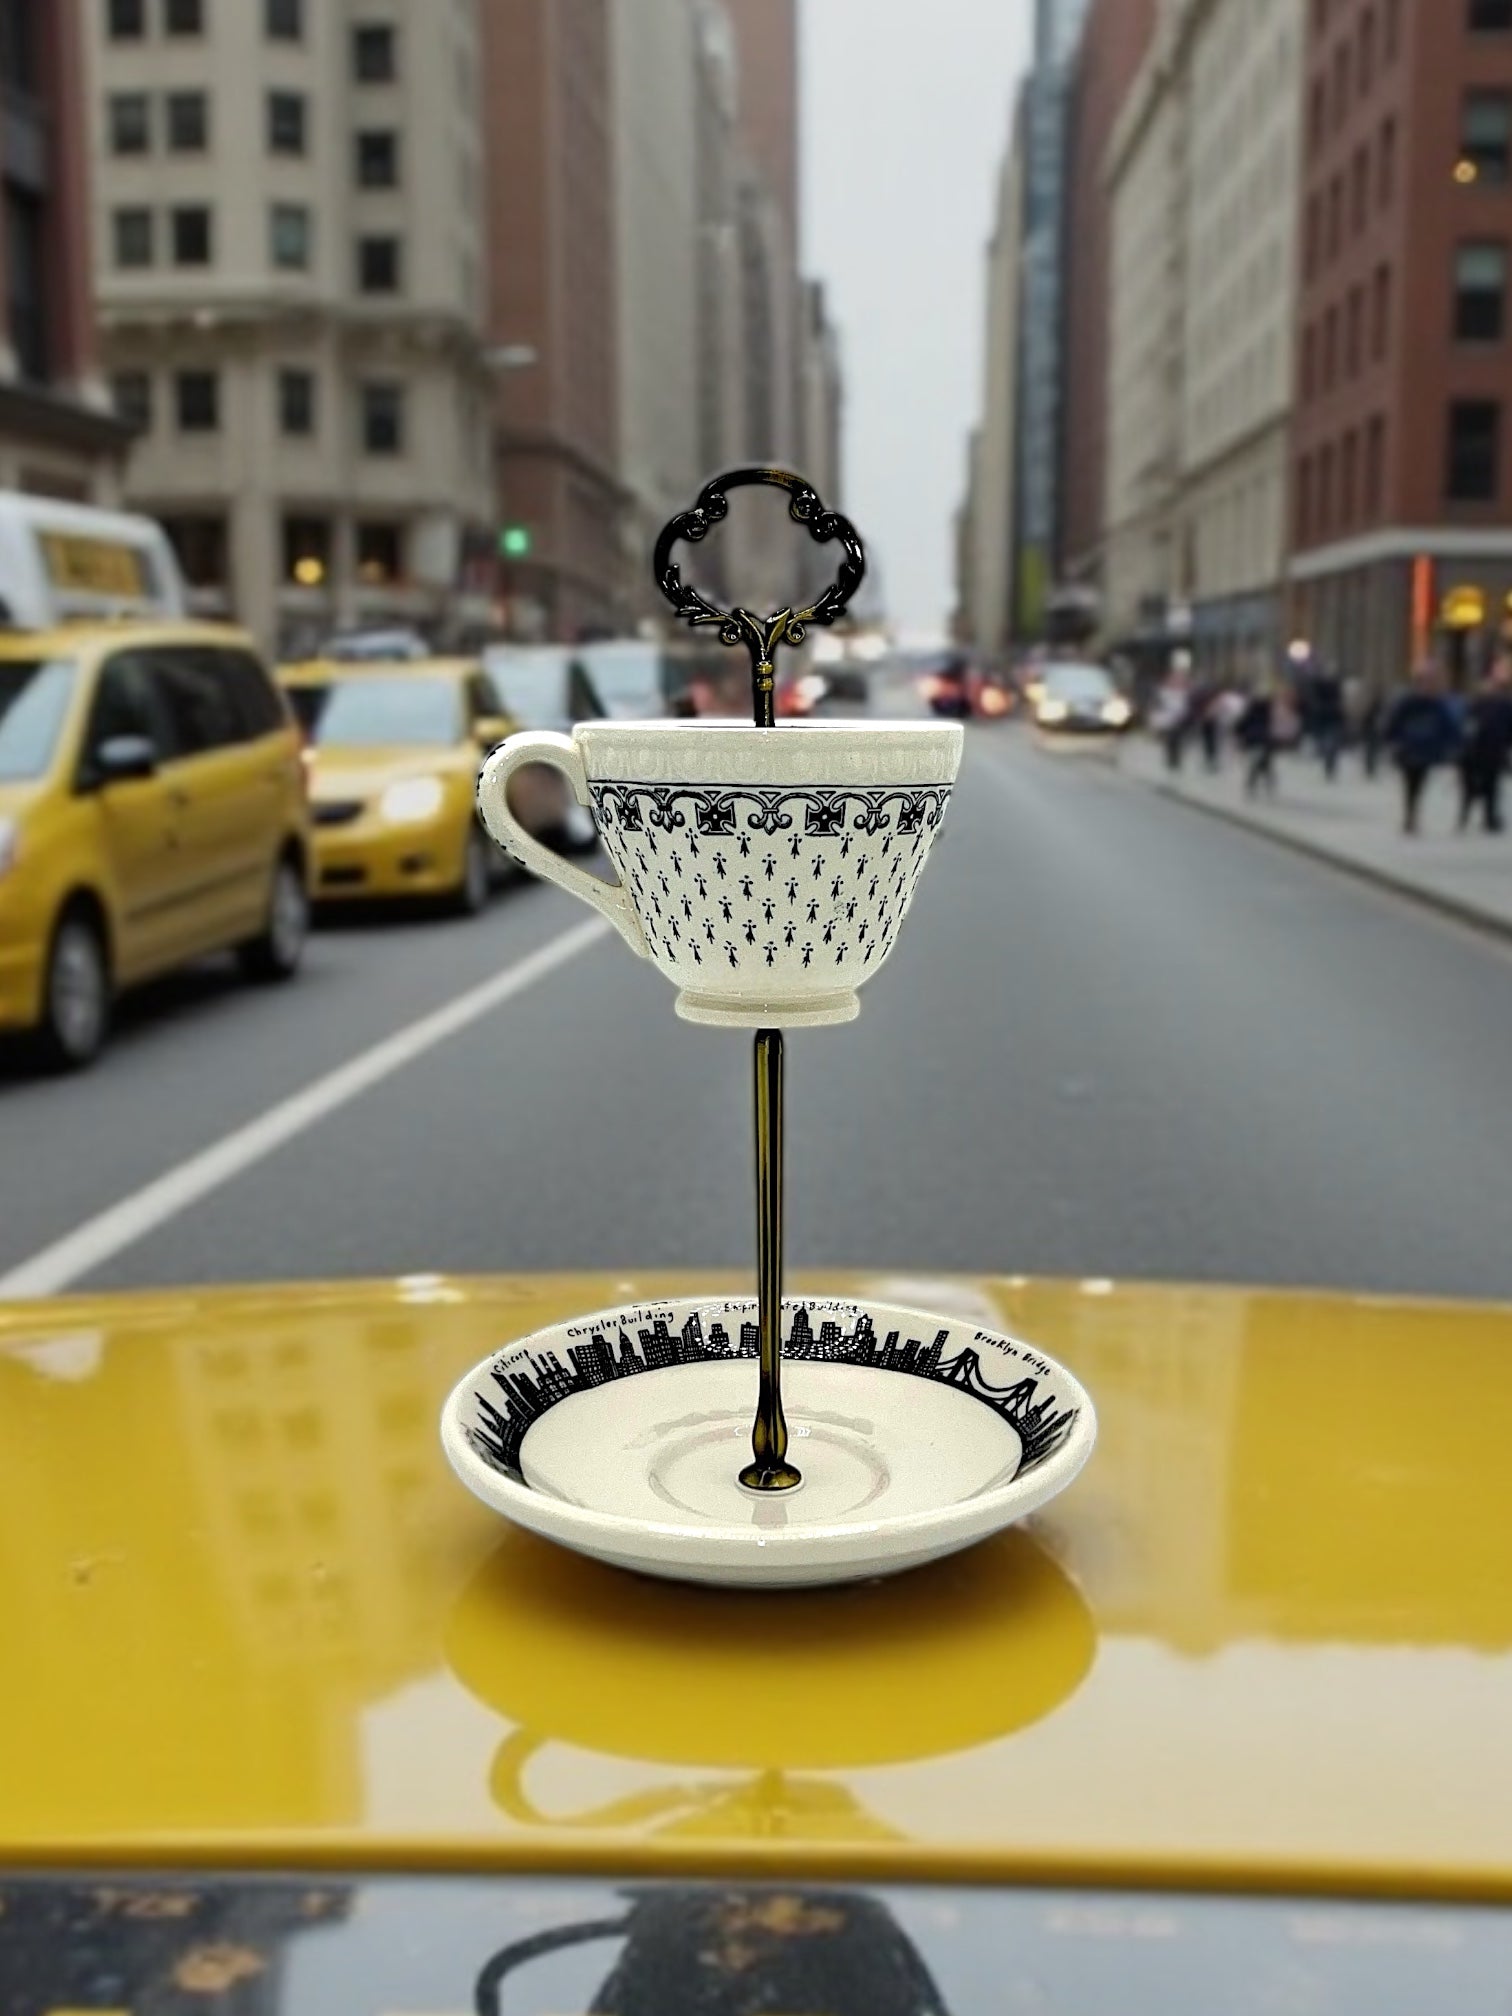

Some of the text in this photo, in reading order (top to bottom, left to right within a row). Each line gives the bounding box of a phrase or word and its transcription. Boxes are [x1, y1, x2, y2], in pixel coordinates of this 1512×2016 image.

[567, 1307, 674, 1337] Chrysler Building
[724, 1302, 758, 1313] Empir
[809, 1301, 857, 1314] Building
[975, 1332, 1051, 1376] Brooklyn Bridge
